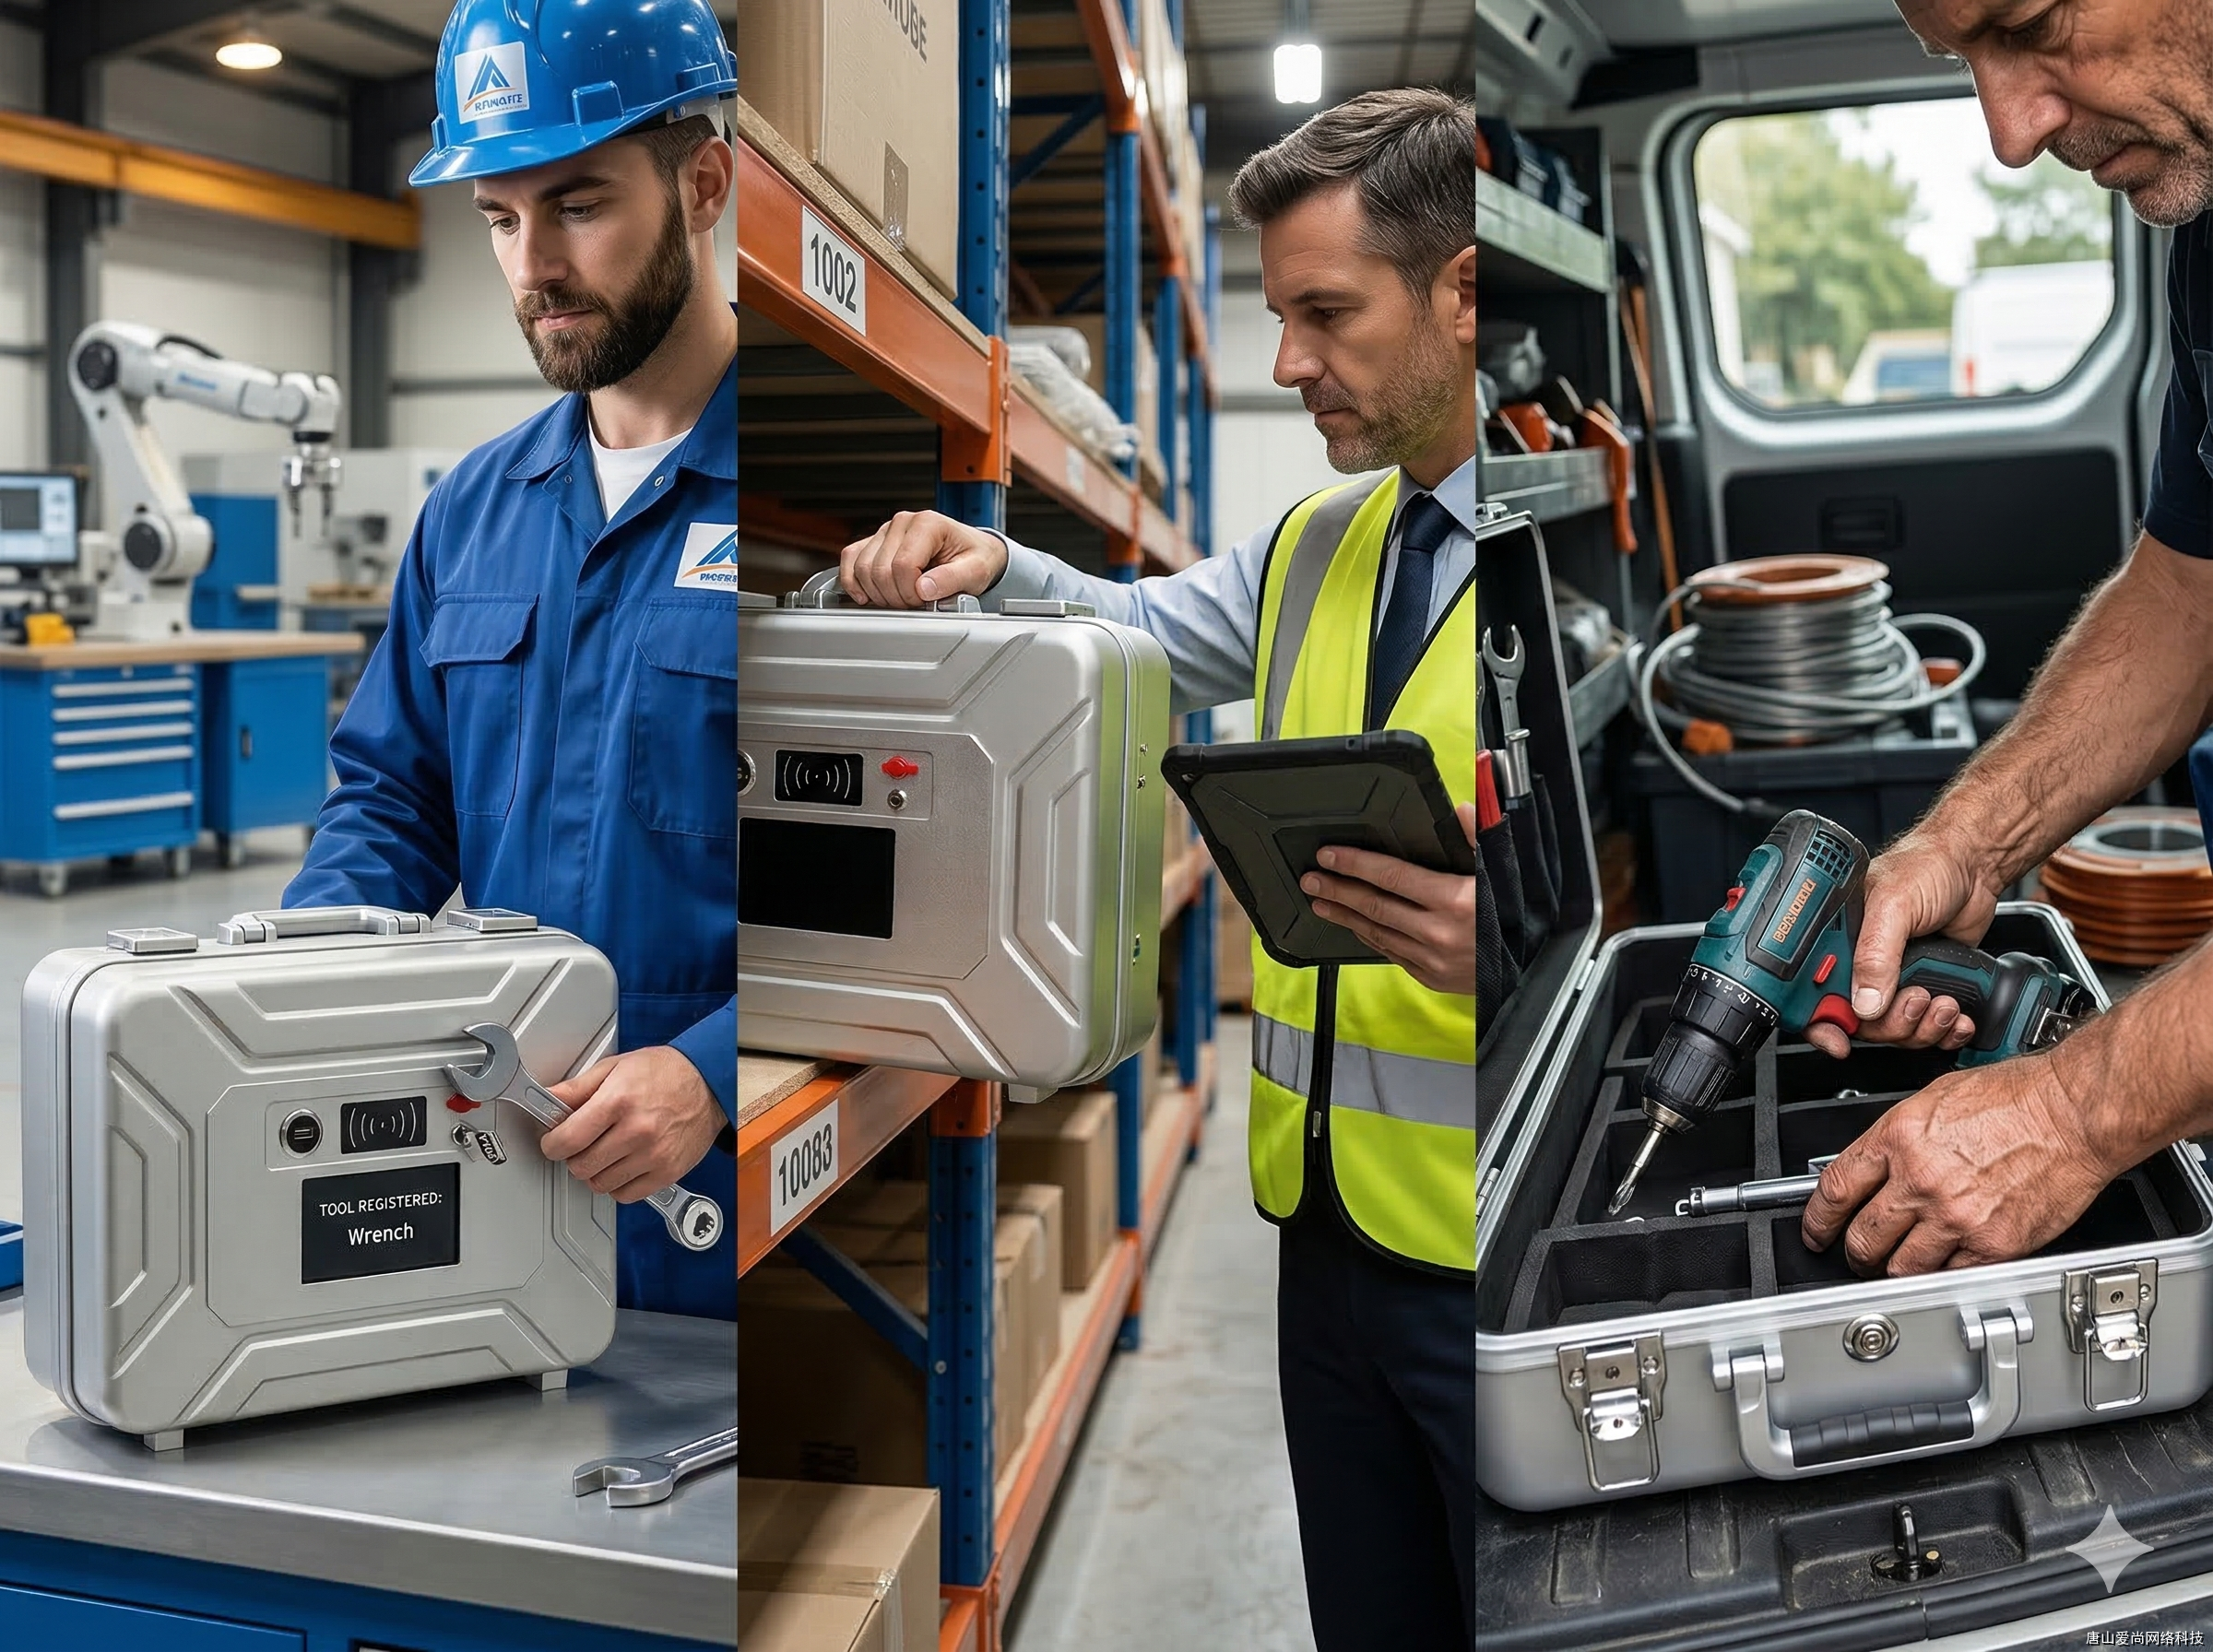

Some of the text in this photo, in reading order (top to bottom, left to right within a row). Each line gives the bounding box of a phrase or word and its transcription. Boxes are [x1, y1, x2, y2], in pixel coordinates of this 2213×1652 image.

[811, 232, 857, 314] 1002
[778, 1123, 833, 1207] 10083
[319, 1192, 443, 1217] TOOL REGISTERED:
[348, 1221, 414, 1246] Wrench
